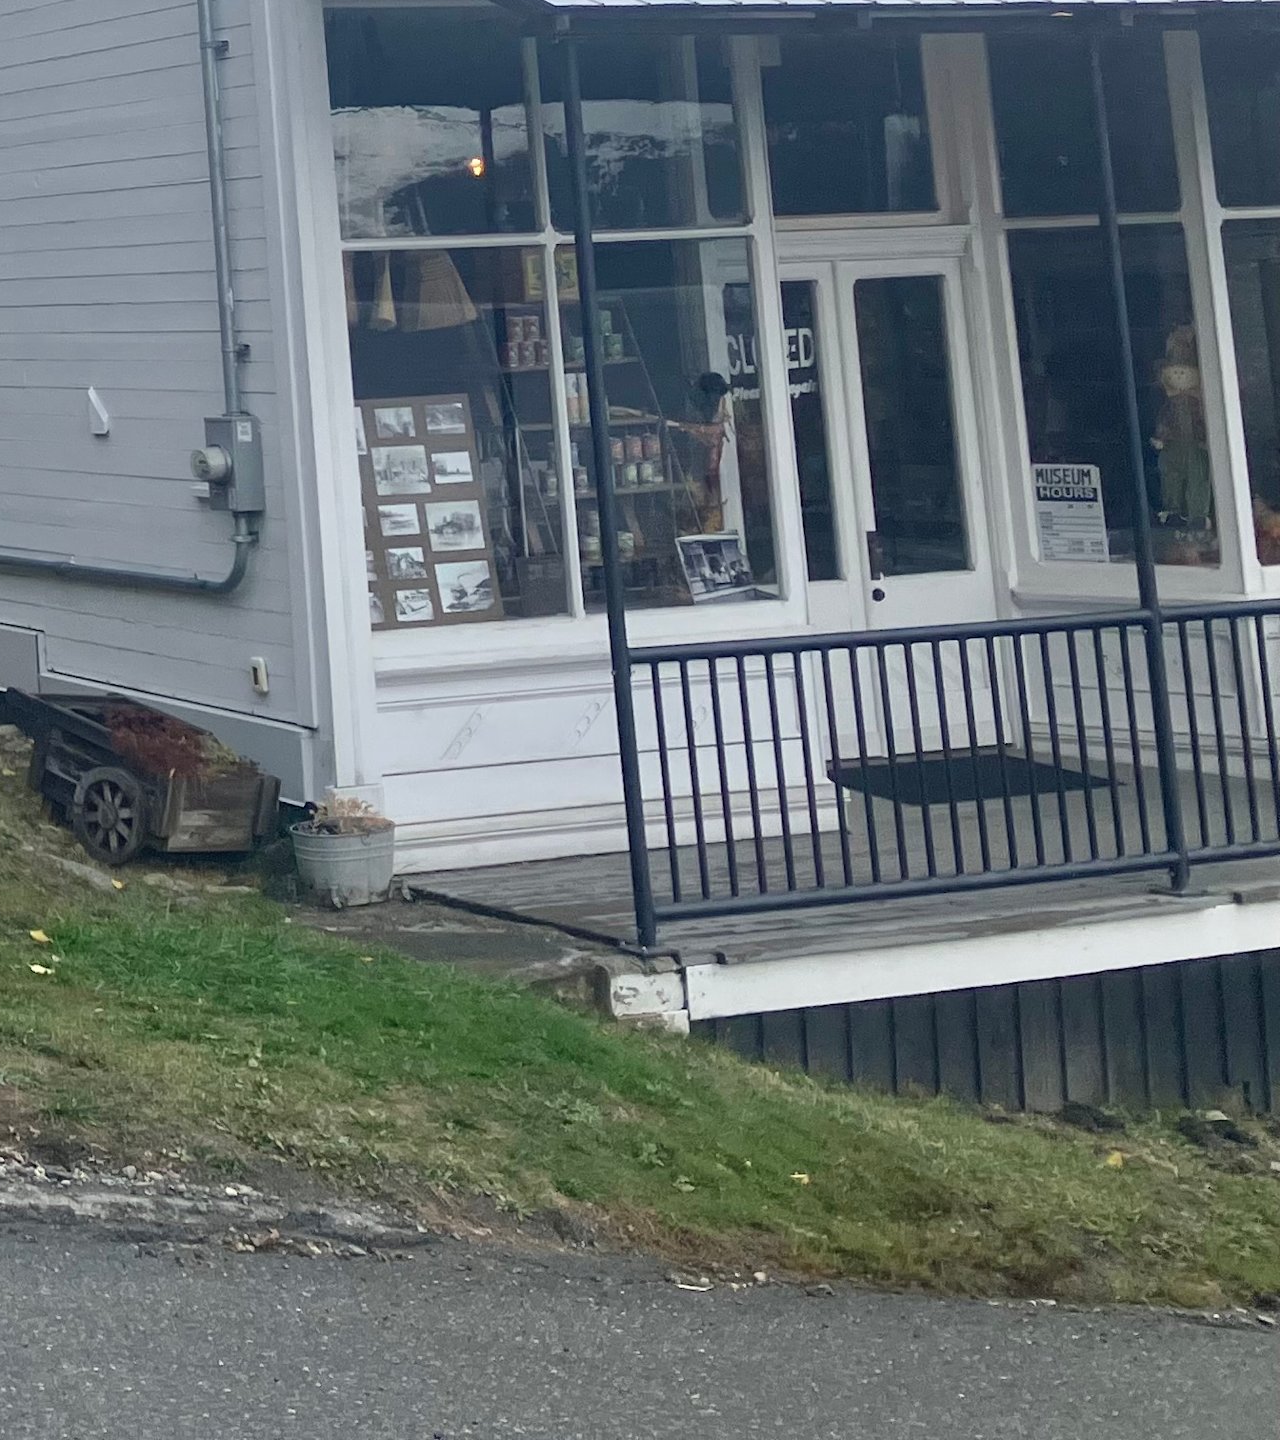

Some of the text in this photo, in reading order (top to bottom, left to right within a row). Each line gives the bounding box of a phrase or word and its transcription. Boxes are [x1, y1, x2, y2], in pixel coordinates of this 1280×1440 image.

[725, 327, 815, 376] CLED
[1035, 468, 1092, 486] MUSEUM
[1039, 487, 1095, 499] HOURS
